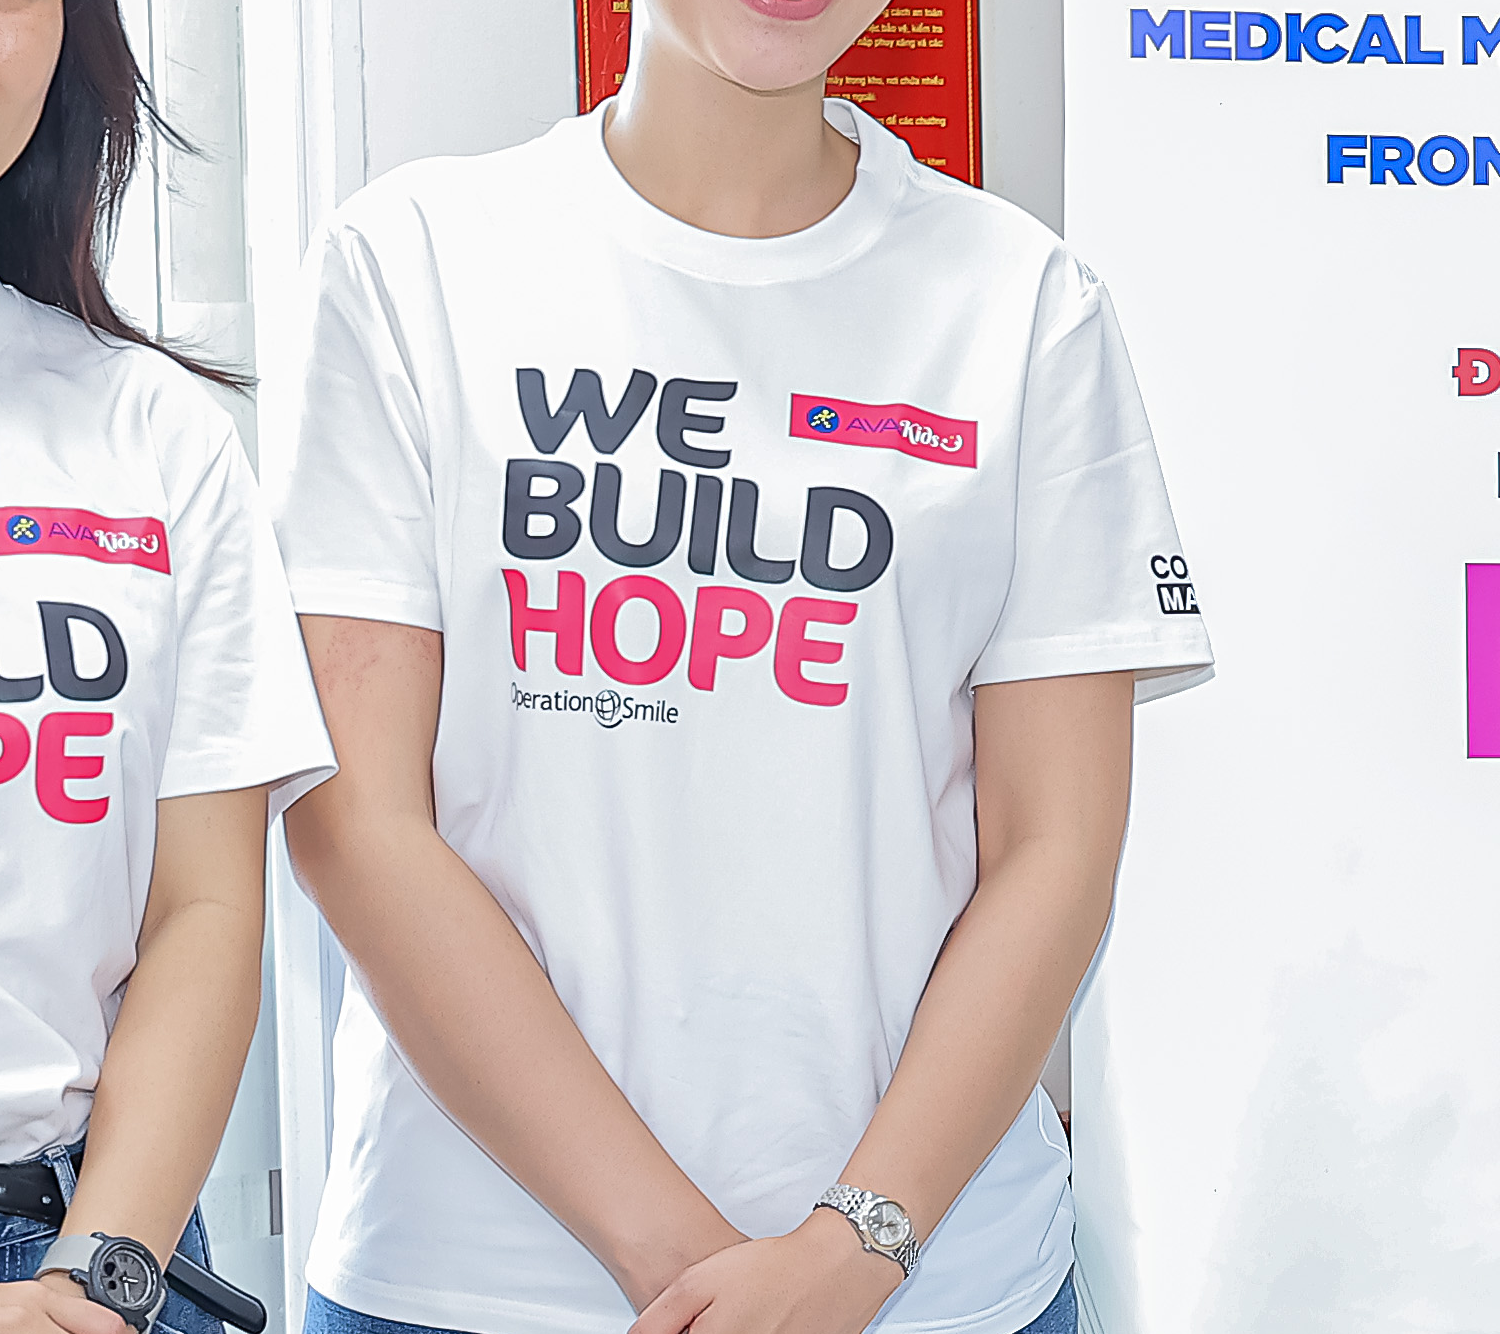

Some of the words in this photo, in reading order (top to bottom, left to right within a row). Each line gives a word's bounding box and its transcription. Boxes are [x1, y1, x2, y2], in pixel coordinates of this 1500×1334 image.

[1130, 9, 1444, 65] MEDICAL
[516, 368, 738, 469] WE
[502, 458, 894, 592] BUILD
[500, 568, 859, 708] HOPE
[511, 683, 594, 718] Operation
[621, 698, 679, 725] Smile
